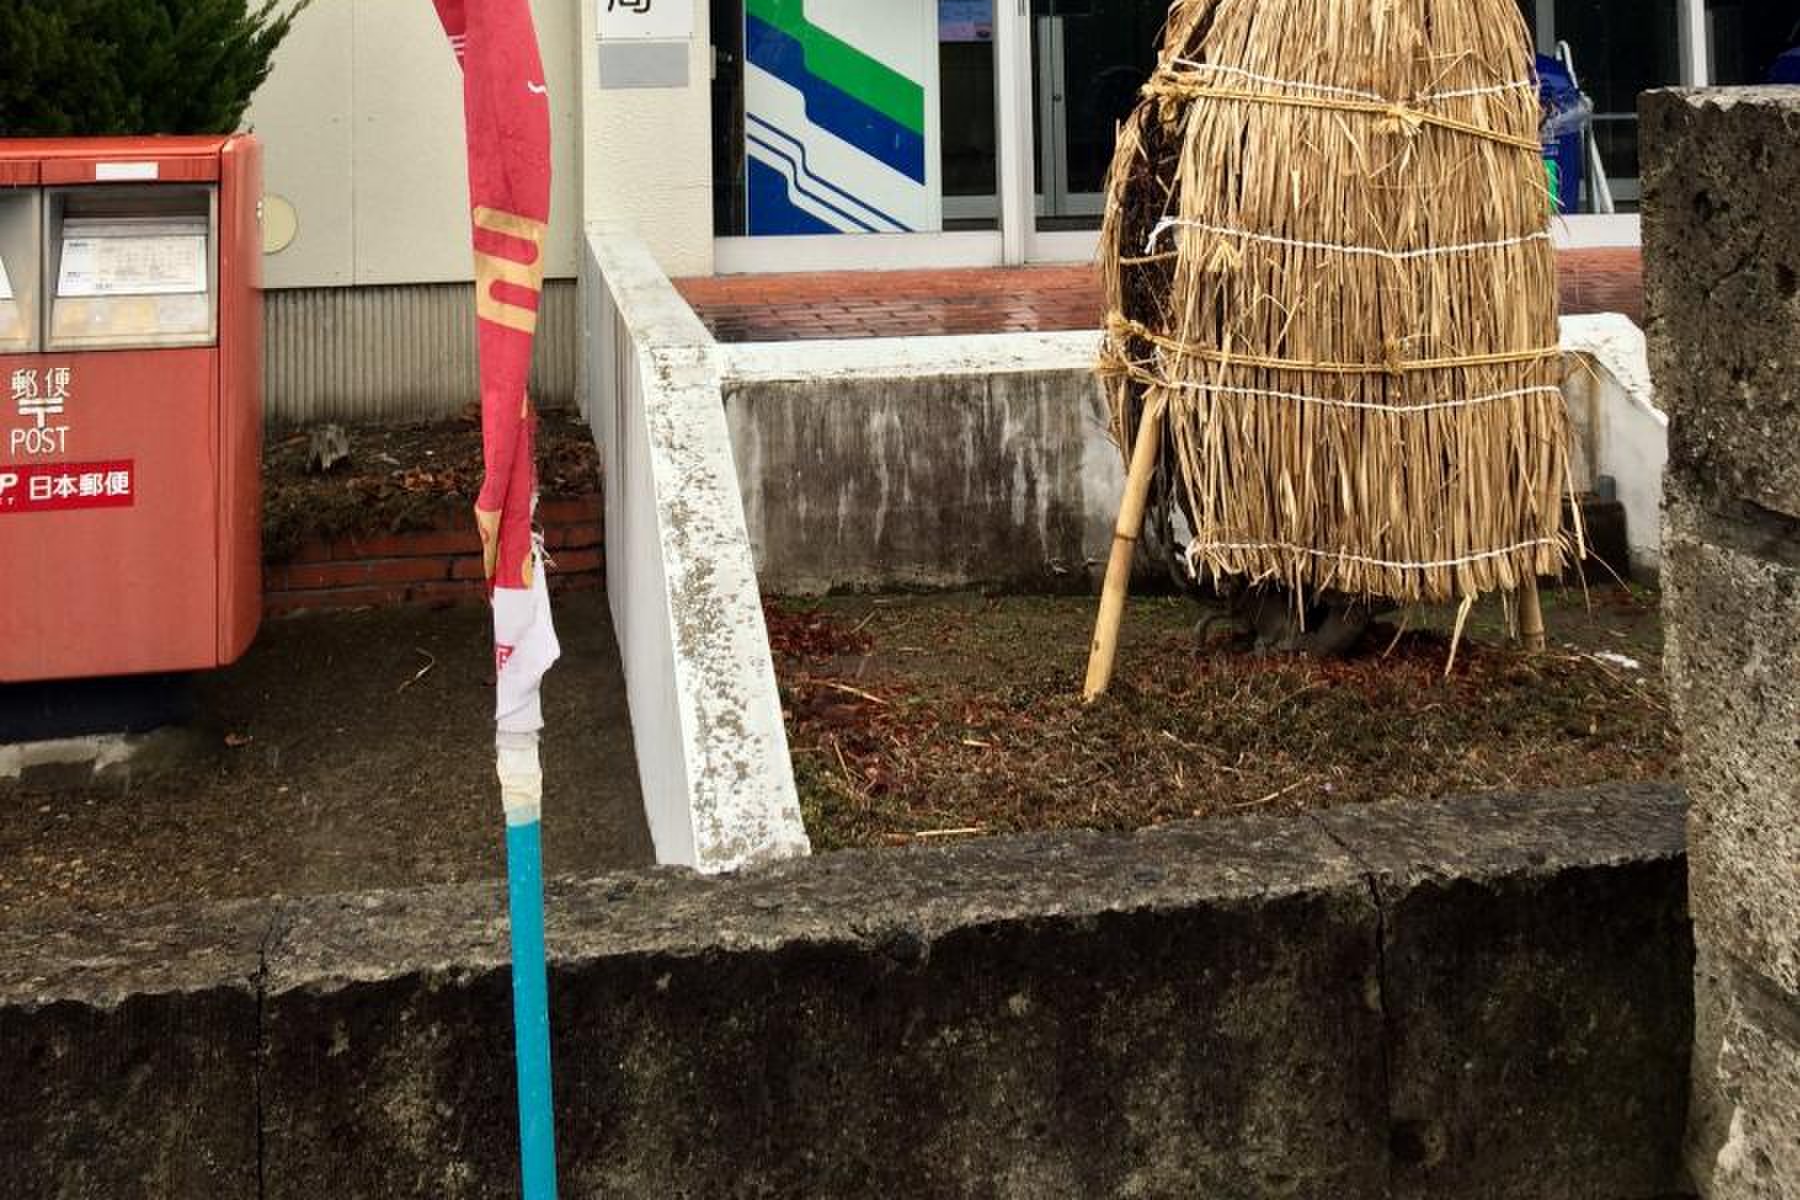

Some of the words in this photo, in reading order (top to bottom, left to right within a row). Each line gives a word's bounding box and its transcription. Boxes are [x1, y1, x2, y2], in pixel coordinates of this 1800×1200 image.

[11, 367, 70, 400] 郵便
[11, 426, 70, 455] POST
[29, 470, 130, 501] 日本郵便
